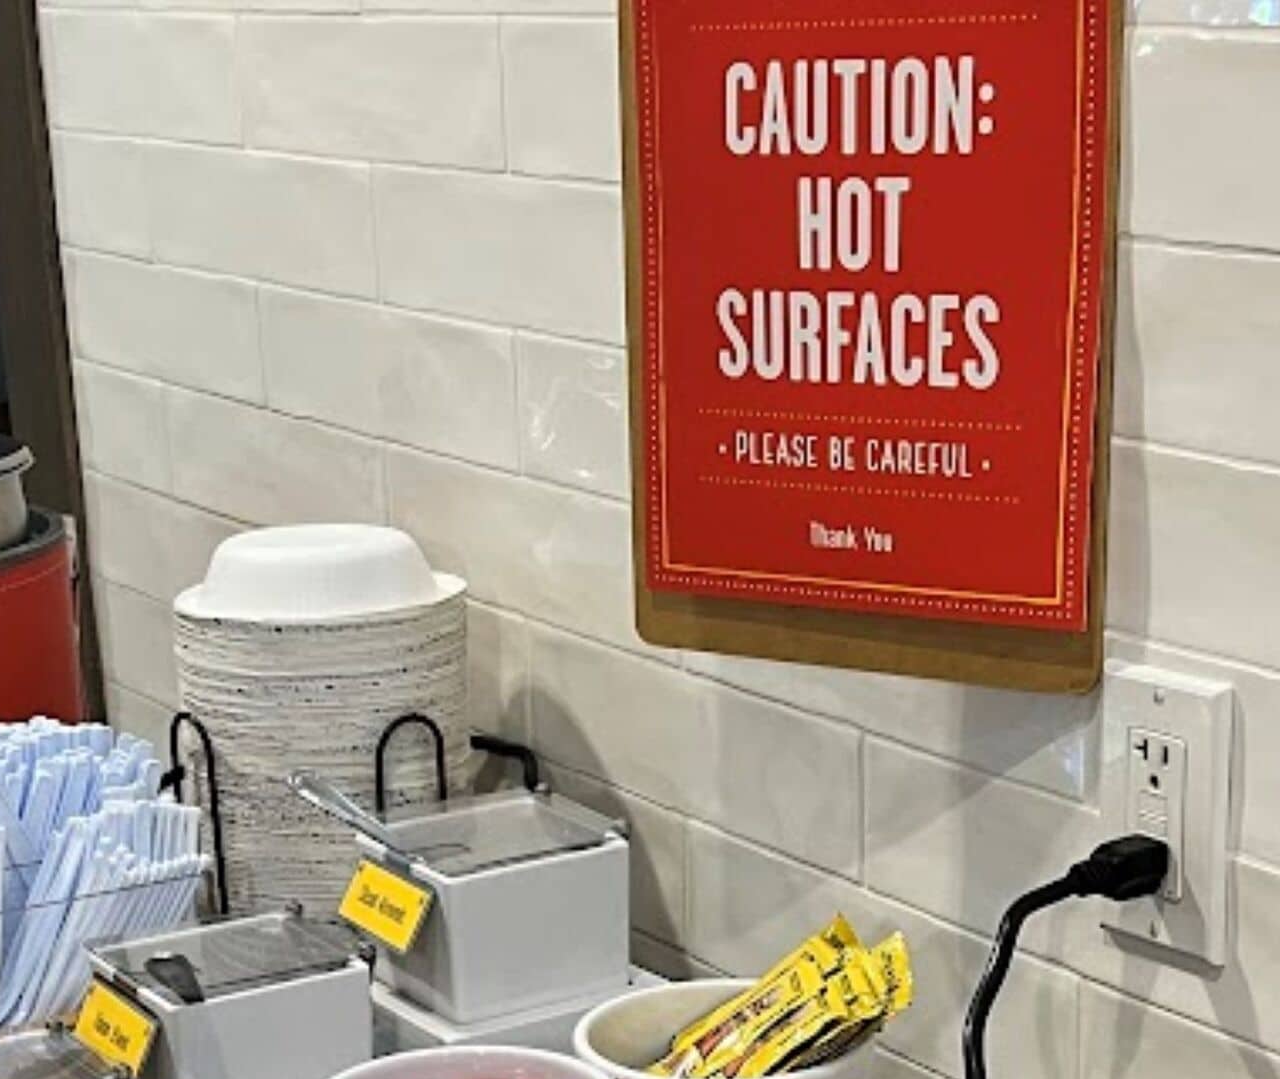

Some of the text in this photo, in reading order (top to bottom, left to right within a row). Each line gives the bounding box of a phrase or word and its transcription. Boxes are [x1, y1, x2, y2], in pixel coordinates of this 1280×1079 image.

[723, 55, 995, 156] CAUTION:
[798, 176, 910, 272] HOT
[716, 289, 1000, 389] SURFACES
[735, 429, 973, 479] PLEASE BE CAREFUL
[810, 520, 893, 553] Thank You
